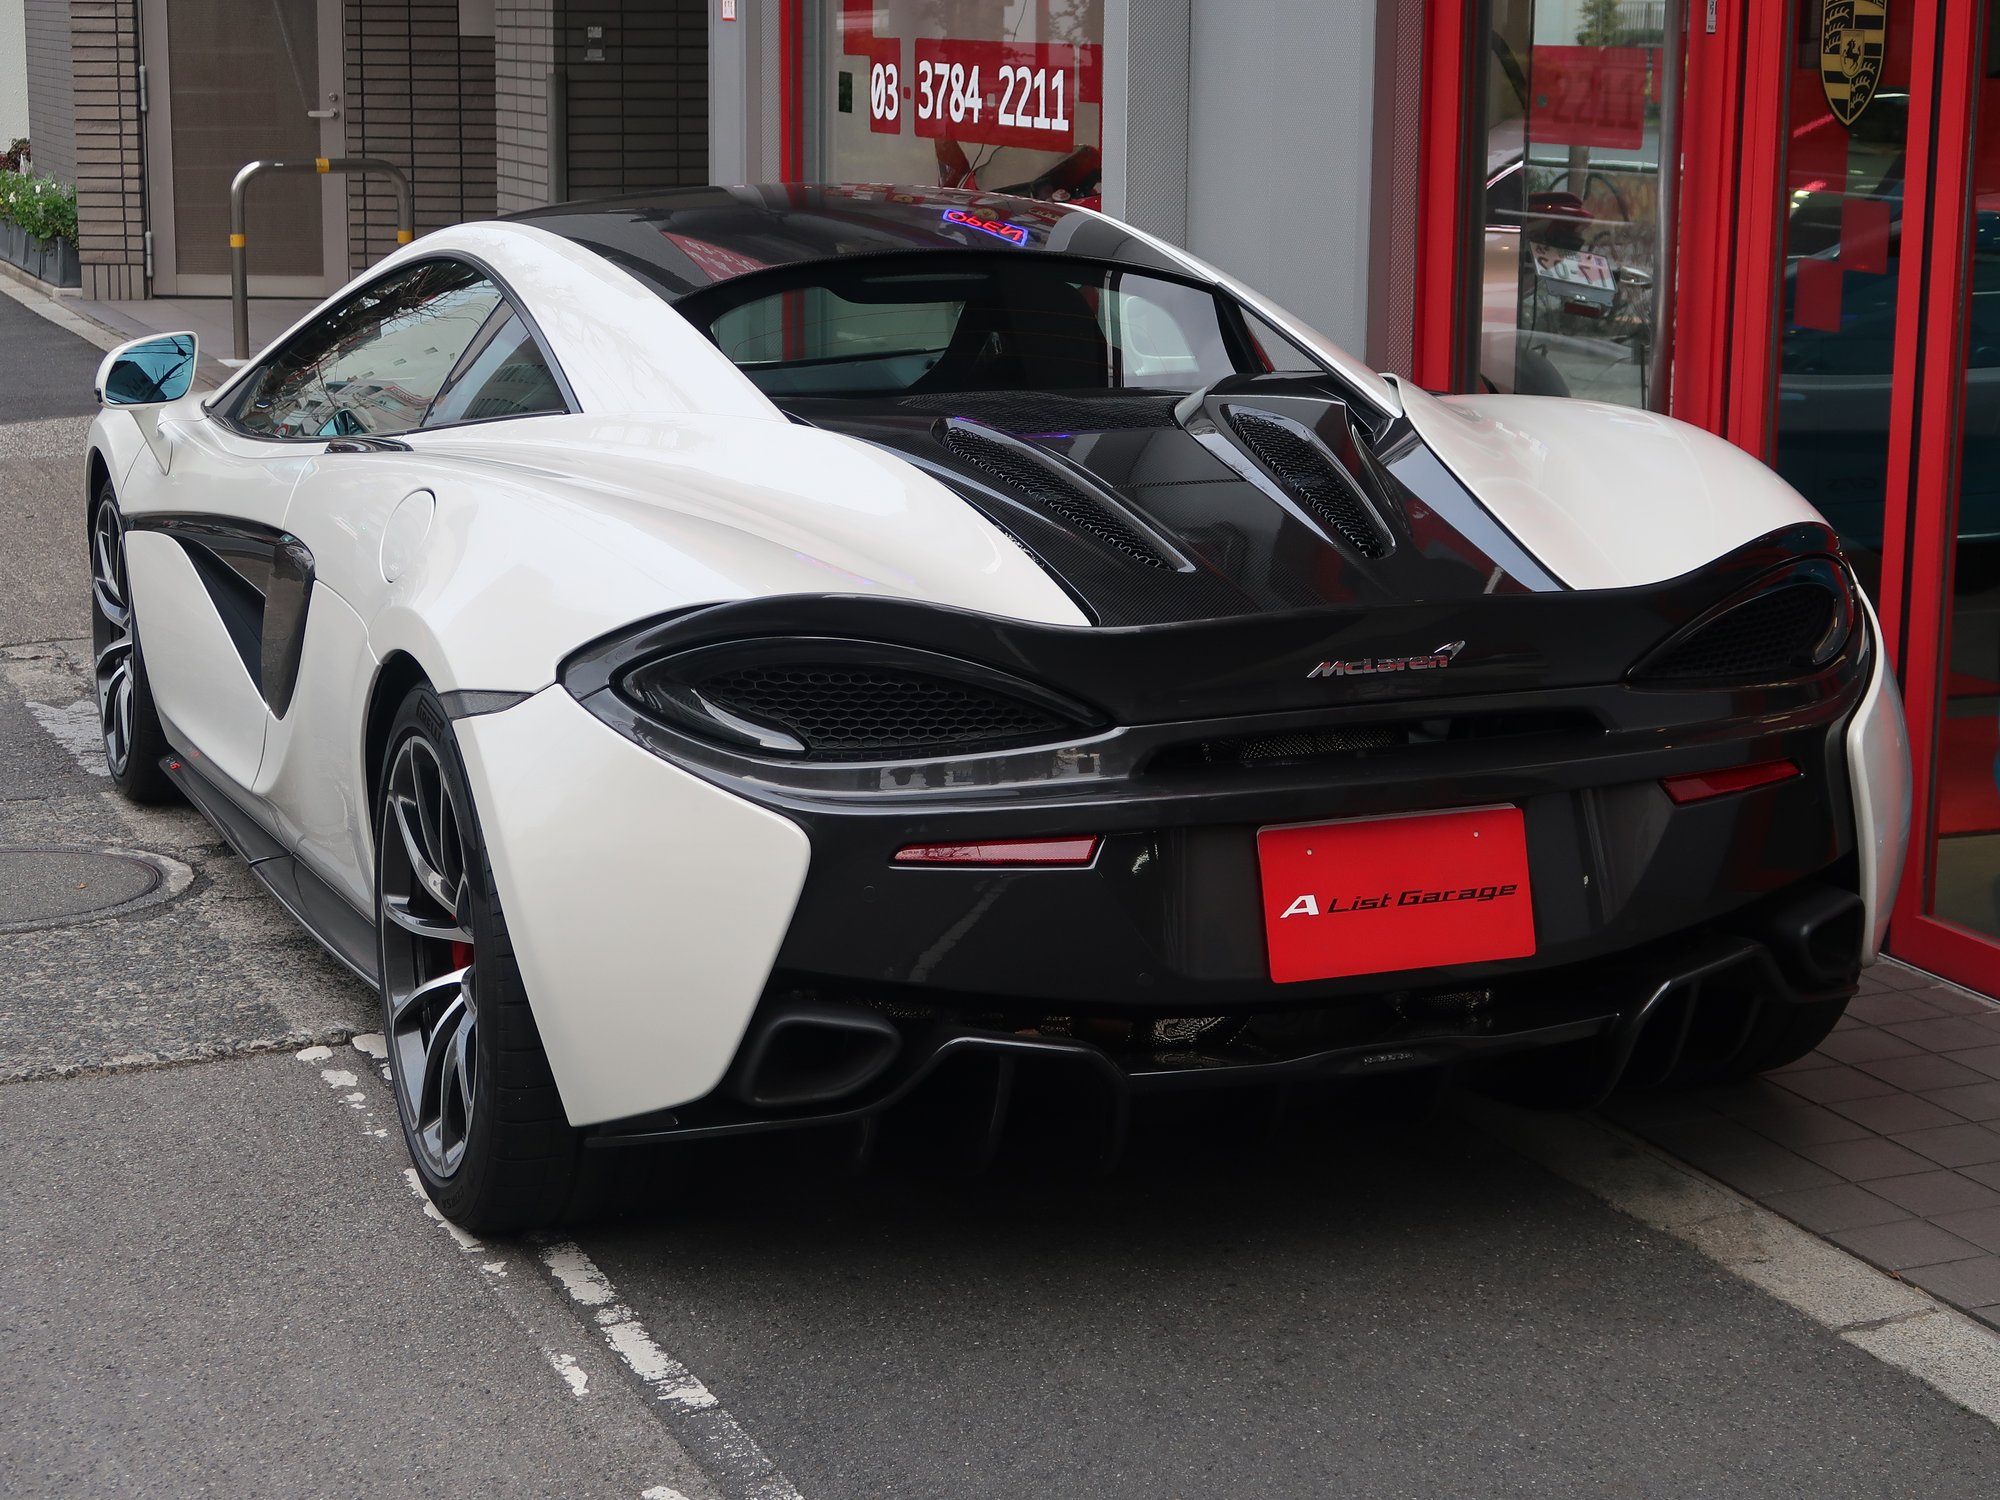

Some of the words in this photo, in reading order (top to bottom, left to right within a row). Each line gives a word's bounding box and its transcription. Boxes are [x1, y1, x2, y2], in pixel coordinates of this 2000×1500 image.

[871, 62, 898, 120] 03
[918, 60, 982, 123] 3784
[998, 65, 1069, 131] 2211
[1306, 654, 1448, 678] McLaren
[1279, 894, 1320, 919] A
[1327, 893, 1393, 914] List
[1397, 883, 1518, 907] Garage
